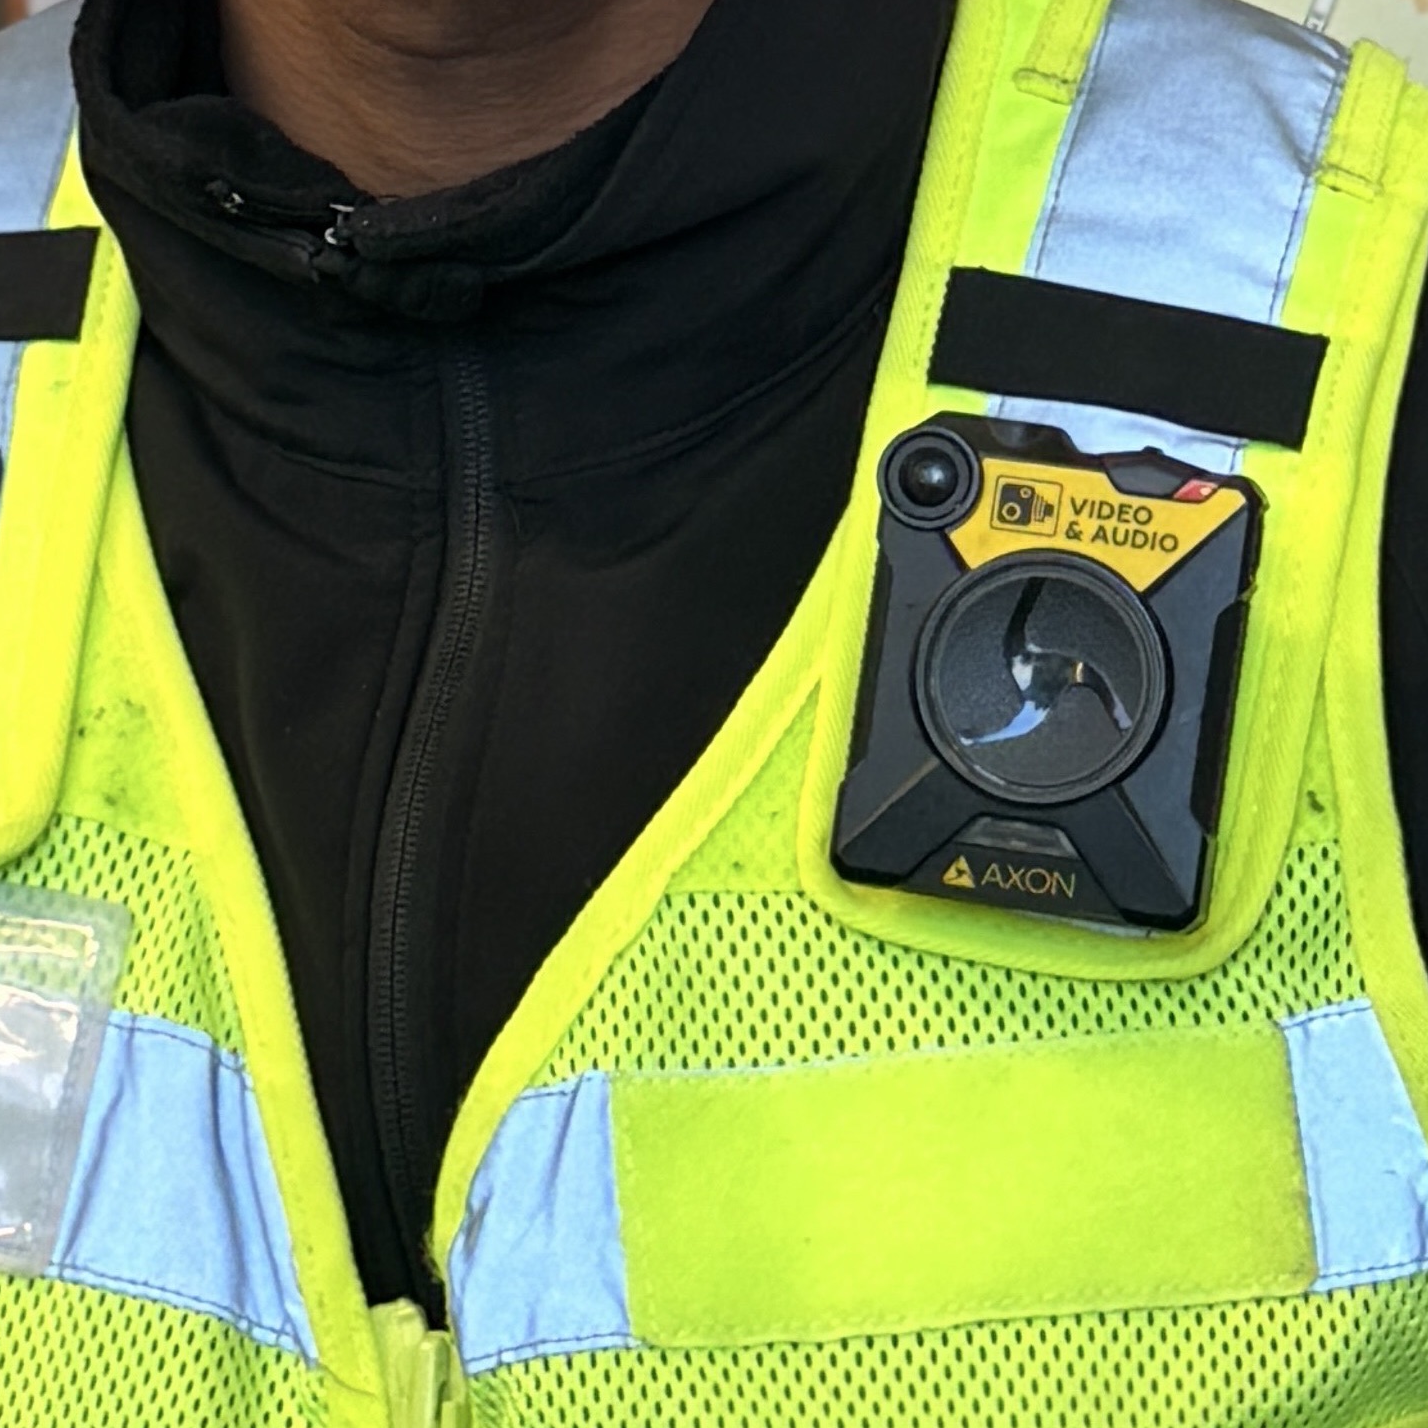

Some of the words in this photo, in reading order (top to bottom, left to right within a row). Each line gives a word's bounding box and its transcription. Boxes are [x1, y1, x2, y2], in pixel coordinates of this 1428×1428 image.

[1070, 497, 1153, 526] VIDEO
[1064, 521, 1084, 541] &
[1090, 526, 1179, 553] AUDIO
[980, 868, 1076, 898] AXON
